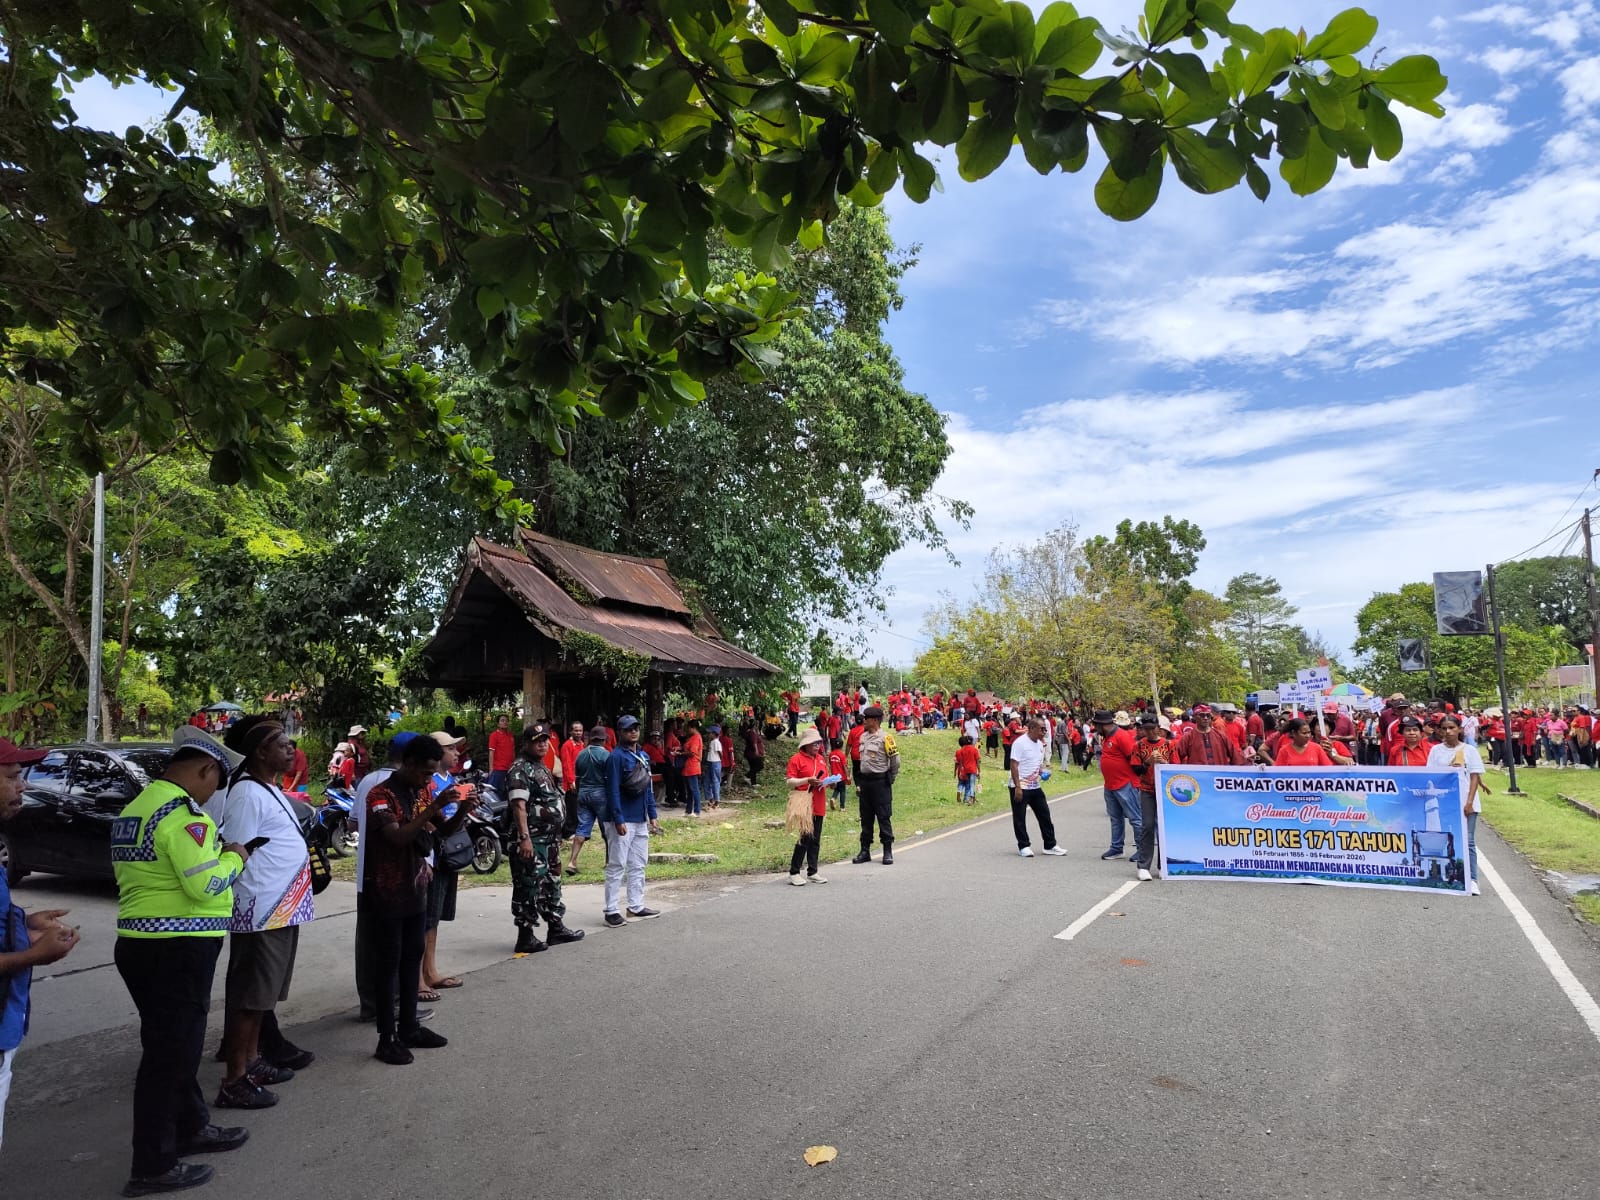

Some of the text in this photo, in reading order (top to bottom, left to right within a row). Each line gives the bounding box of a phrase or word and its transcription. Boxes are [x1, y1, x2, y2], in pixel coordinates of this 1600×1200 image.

[1215, 778, 1272, 791] JEMAAT
[1275, 779, 1299, 791] GKI
[1302, 779, 1397, 793] MARANATHA
[1246, 803, 1366, 826] Selamat Merayakan
[1213, 827, 1407, 853] HUT PI KE 171 TAHUN
[1263, 850, 1289, 858] Februari
[1319, 852, 1345, 860] Februari
[1203, 858, 1226, 869] Tema
[1286, 860, 1354, 874] MENDATANGKAN
